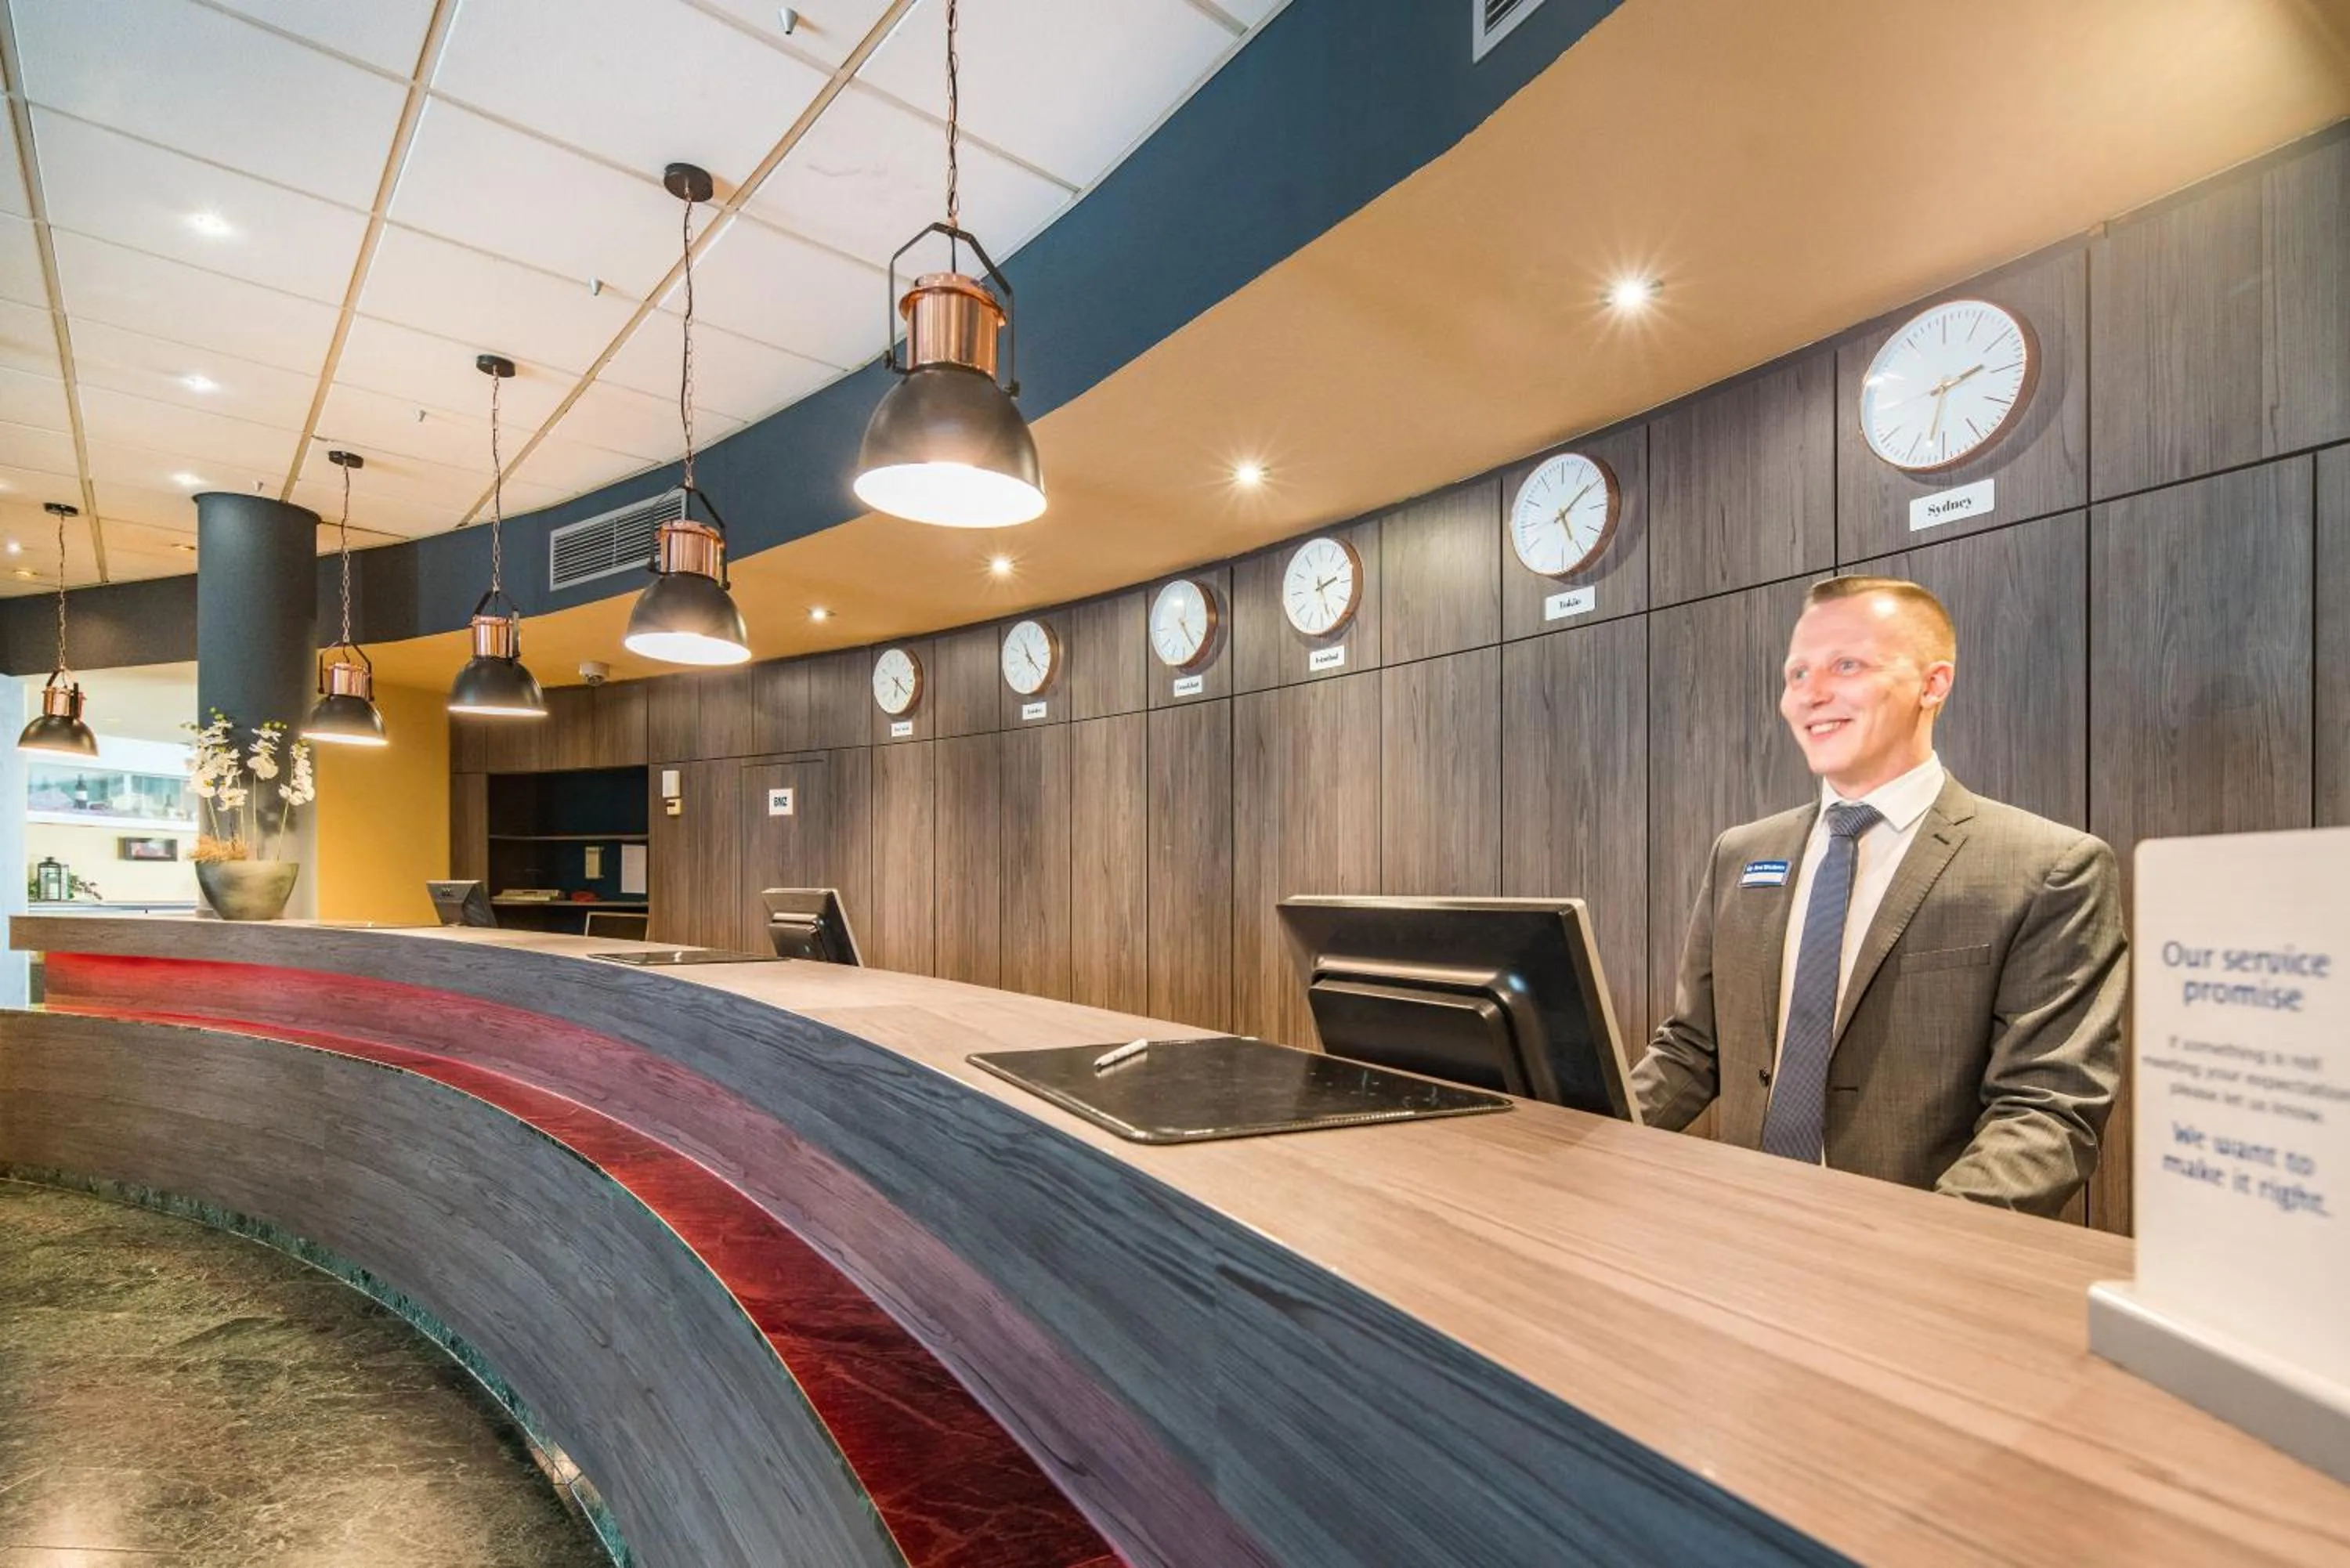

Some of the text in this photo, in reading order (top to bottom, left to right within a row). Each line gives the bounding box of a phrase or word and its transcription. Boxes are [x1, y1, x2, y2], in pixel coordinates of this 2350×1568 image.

[1927, 497, 1972, 517] Sydney
[2162, 940, 2332, 978] Our service
[2183, 979, 2305, 1012] promise
[2171, 1120, 2317, 1178] We want to
[2162, 1153, 2225, 1188] make
[2232, 1166, 2251, 1195] it
